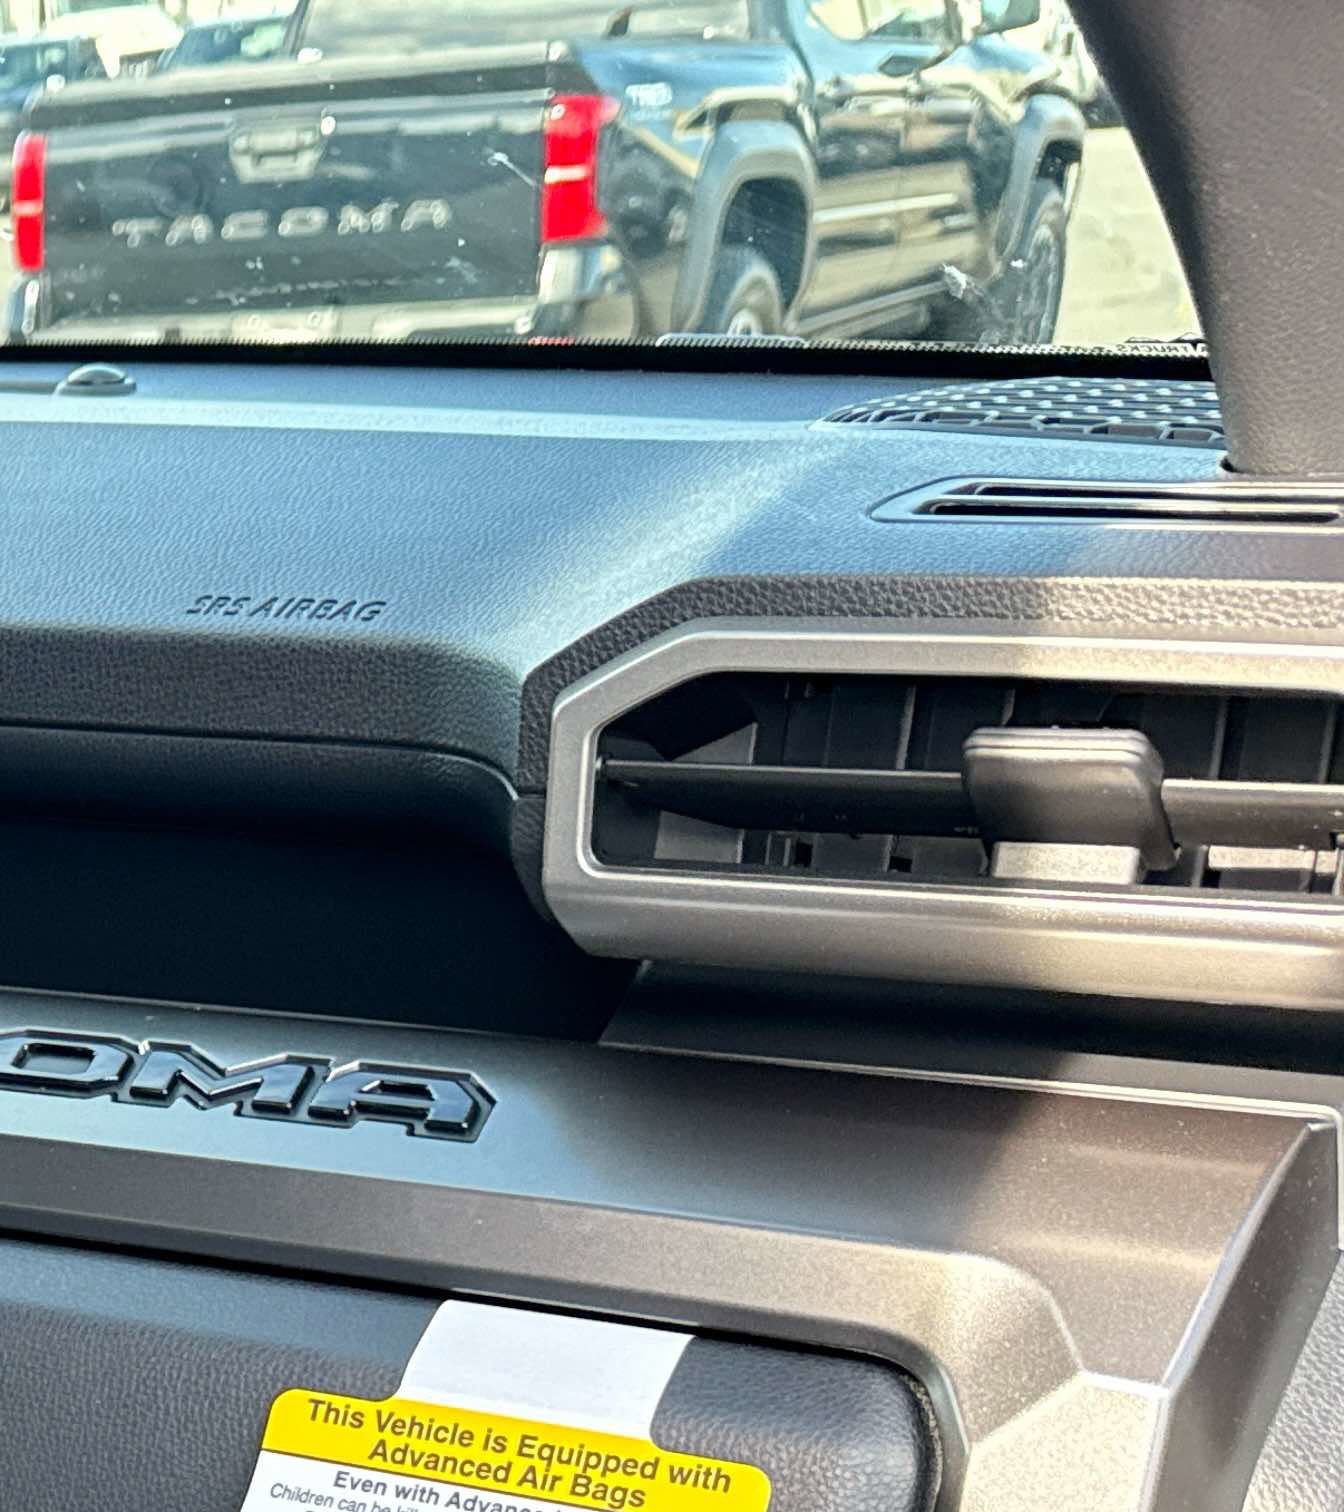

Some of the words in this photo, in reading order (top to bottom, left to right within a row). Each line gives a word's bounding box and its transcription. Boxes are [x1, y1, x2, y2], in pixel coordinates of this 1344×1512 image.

[111, 197, 453, 248] TACOMA
[185, 594, 252, 616] SRS
[249, 596, 388, 622] AIRBAG
[308, 1397, 365, 1430] This
[375, 1408, 475, 1448] Vehicle
[482, 1427, 508, 1454] is
[517, 1433, 661, 1480] Equipped
[668, 1463, 732, 1494] with
[269, 1482, 334, 1508] Children
[332, 1470, 388, 1496] Even
[395, 1484, 440, 1506] with
[367, 1438, 512, 1484] Advanced
[517, 1463, 562, 1492] Air
[569, 1472, 646, 1509] Bags
